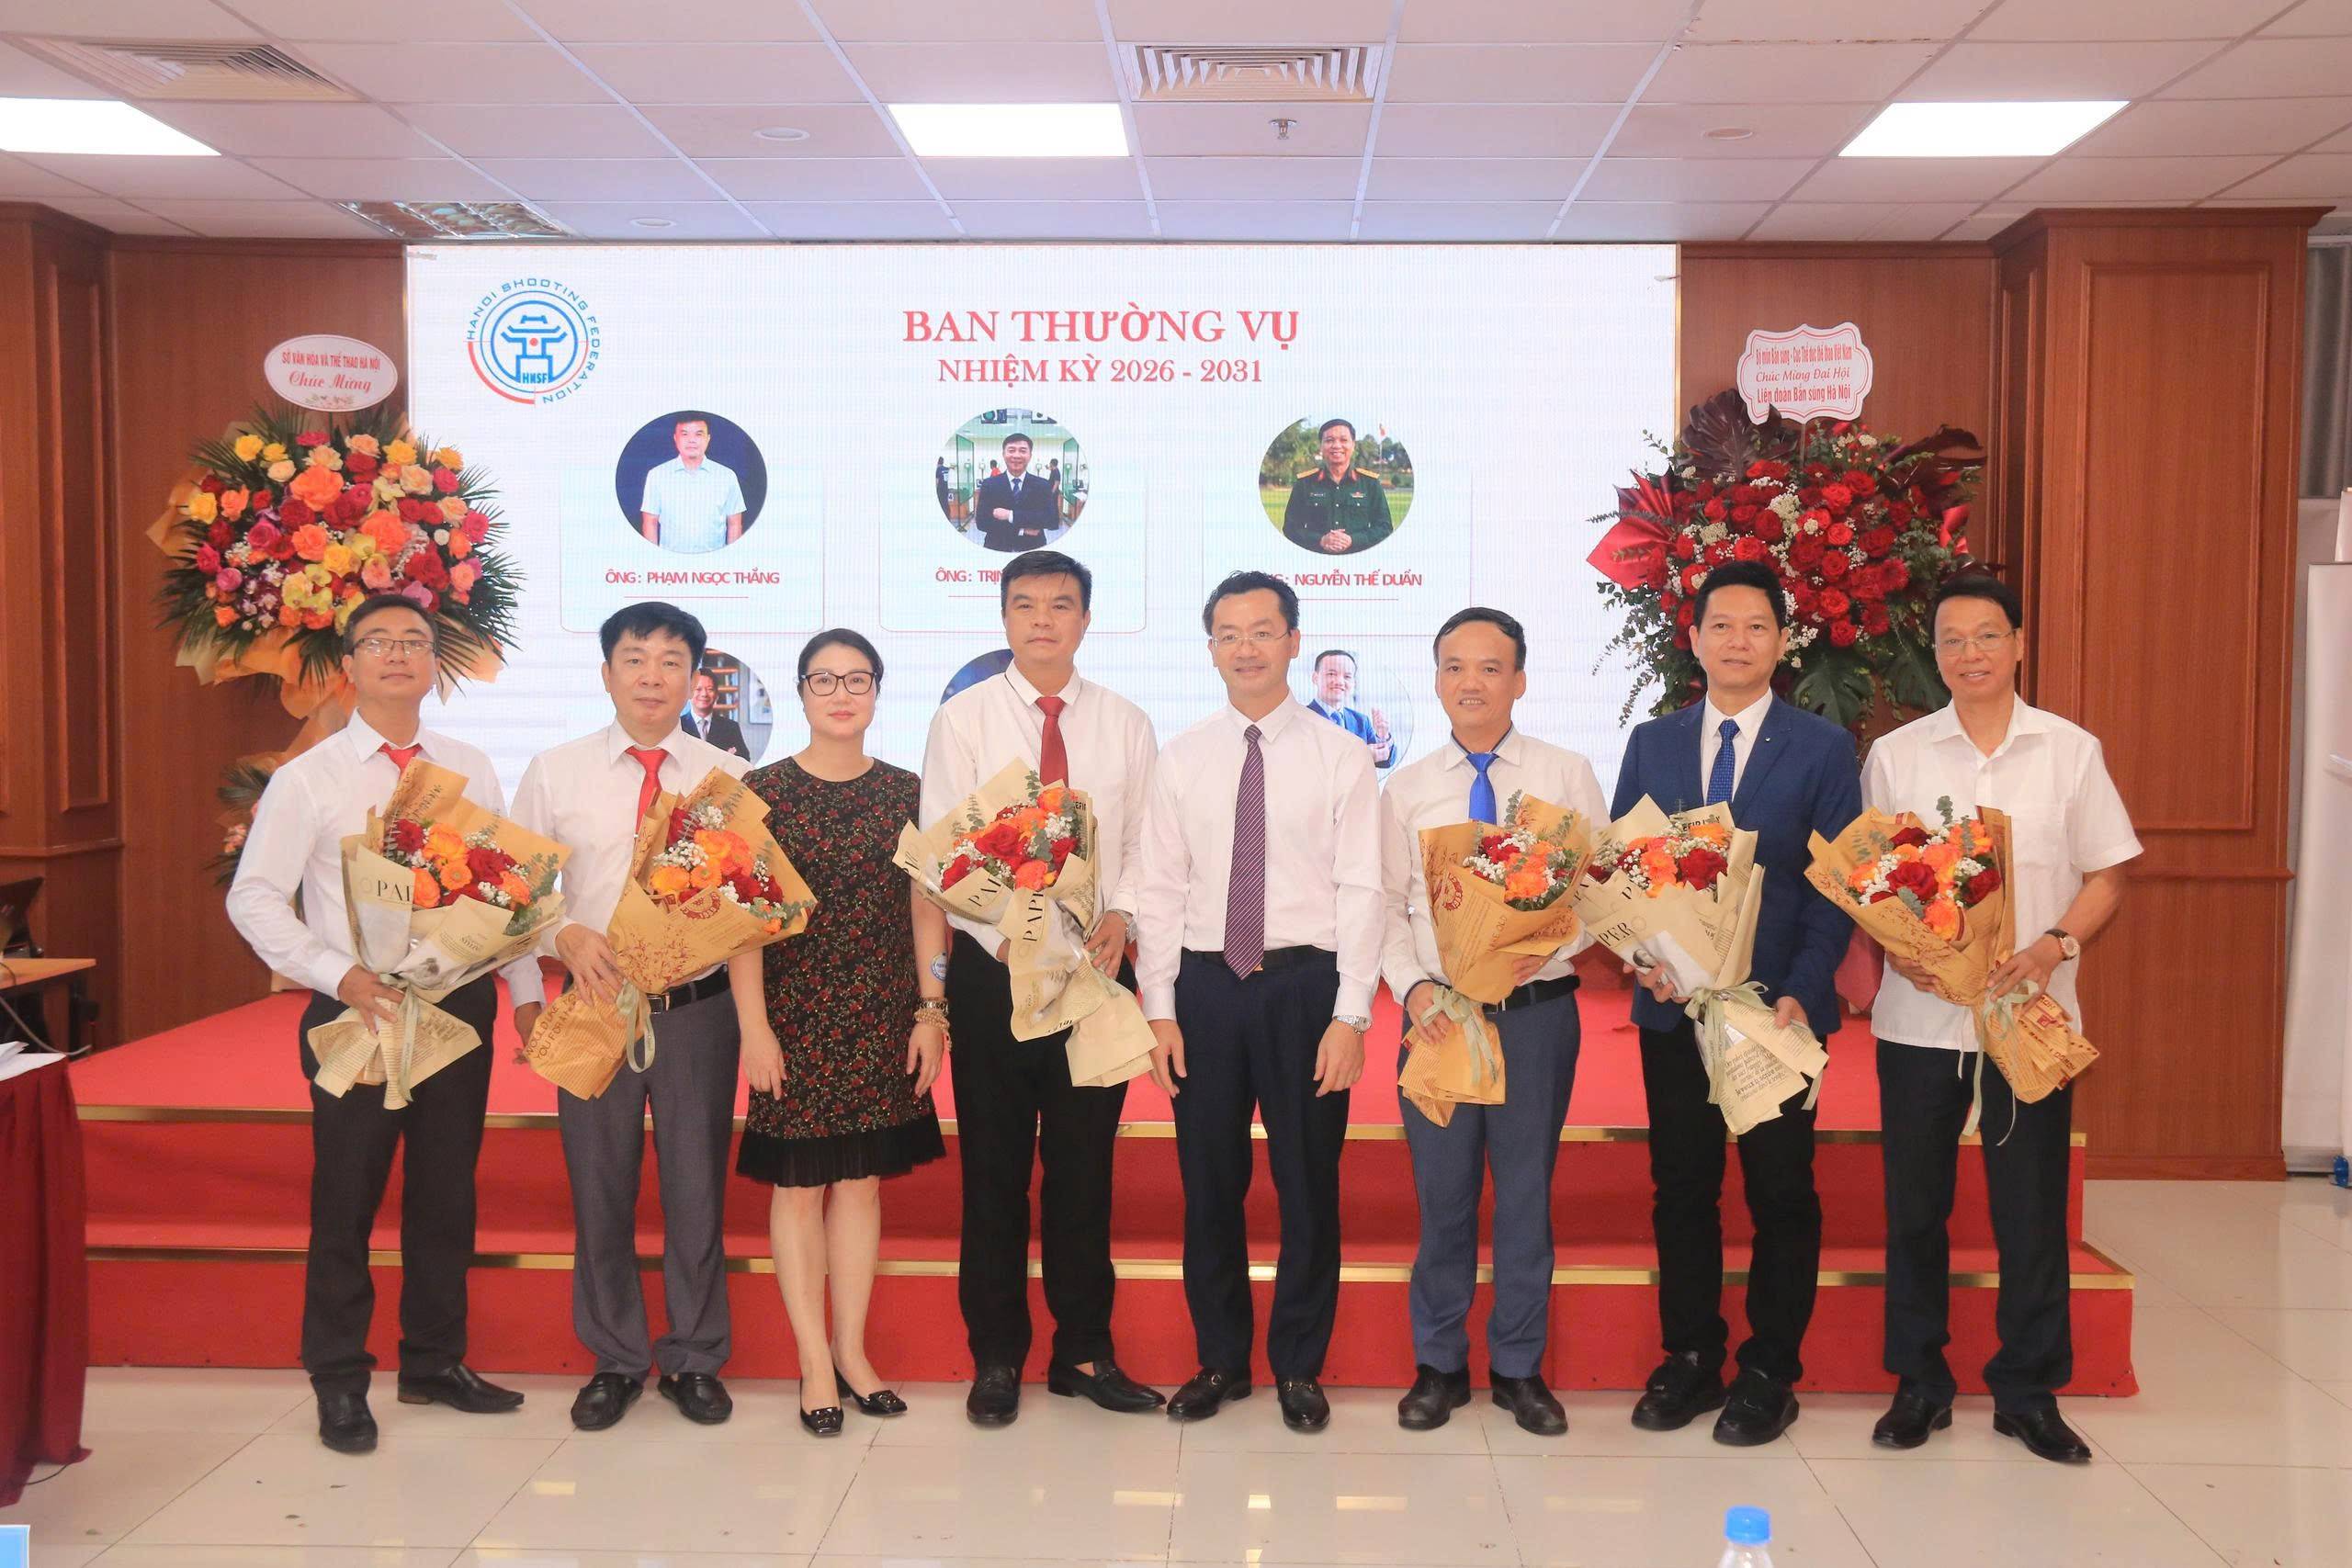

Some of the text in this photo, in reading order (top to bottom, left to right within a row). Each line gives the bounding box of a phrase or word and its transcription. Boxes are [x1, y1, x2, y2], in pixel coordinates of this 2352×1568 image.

[903, 301, 1299, 350] BAN THƯỜNG VỤ
[467, 277, 601, 404] HANOI SHOOTING FEDERATION
[522, 373, 548, 384] HNSF
[939, 354, 1048, 388] NHIỆM
[1059, 354, 1101, 381] KỲ
[1111, 359, 1174, 382] 2026
[1201, 359, 1262, 382] 2031
[1756, 370, 1780, 382] Chúc
[1814, 367, 1830, 381] Đại
[1833, 366, 1850, 380] Hội
[1758, 382, 1850, 403] Liên đoàn Bắn súng Hà Nội
[647, 571, 688, 585] PHẠM
[692, 571, 731, 585] NGỌC
[1295, 569, 1351, 585] NGUYỄN
[1354, 569, 1380, 585] THẾ
